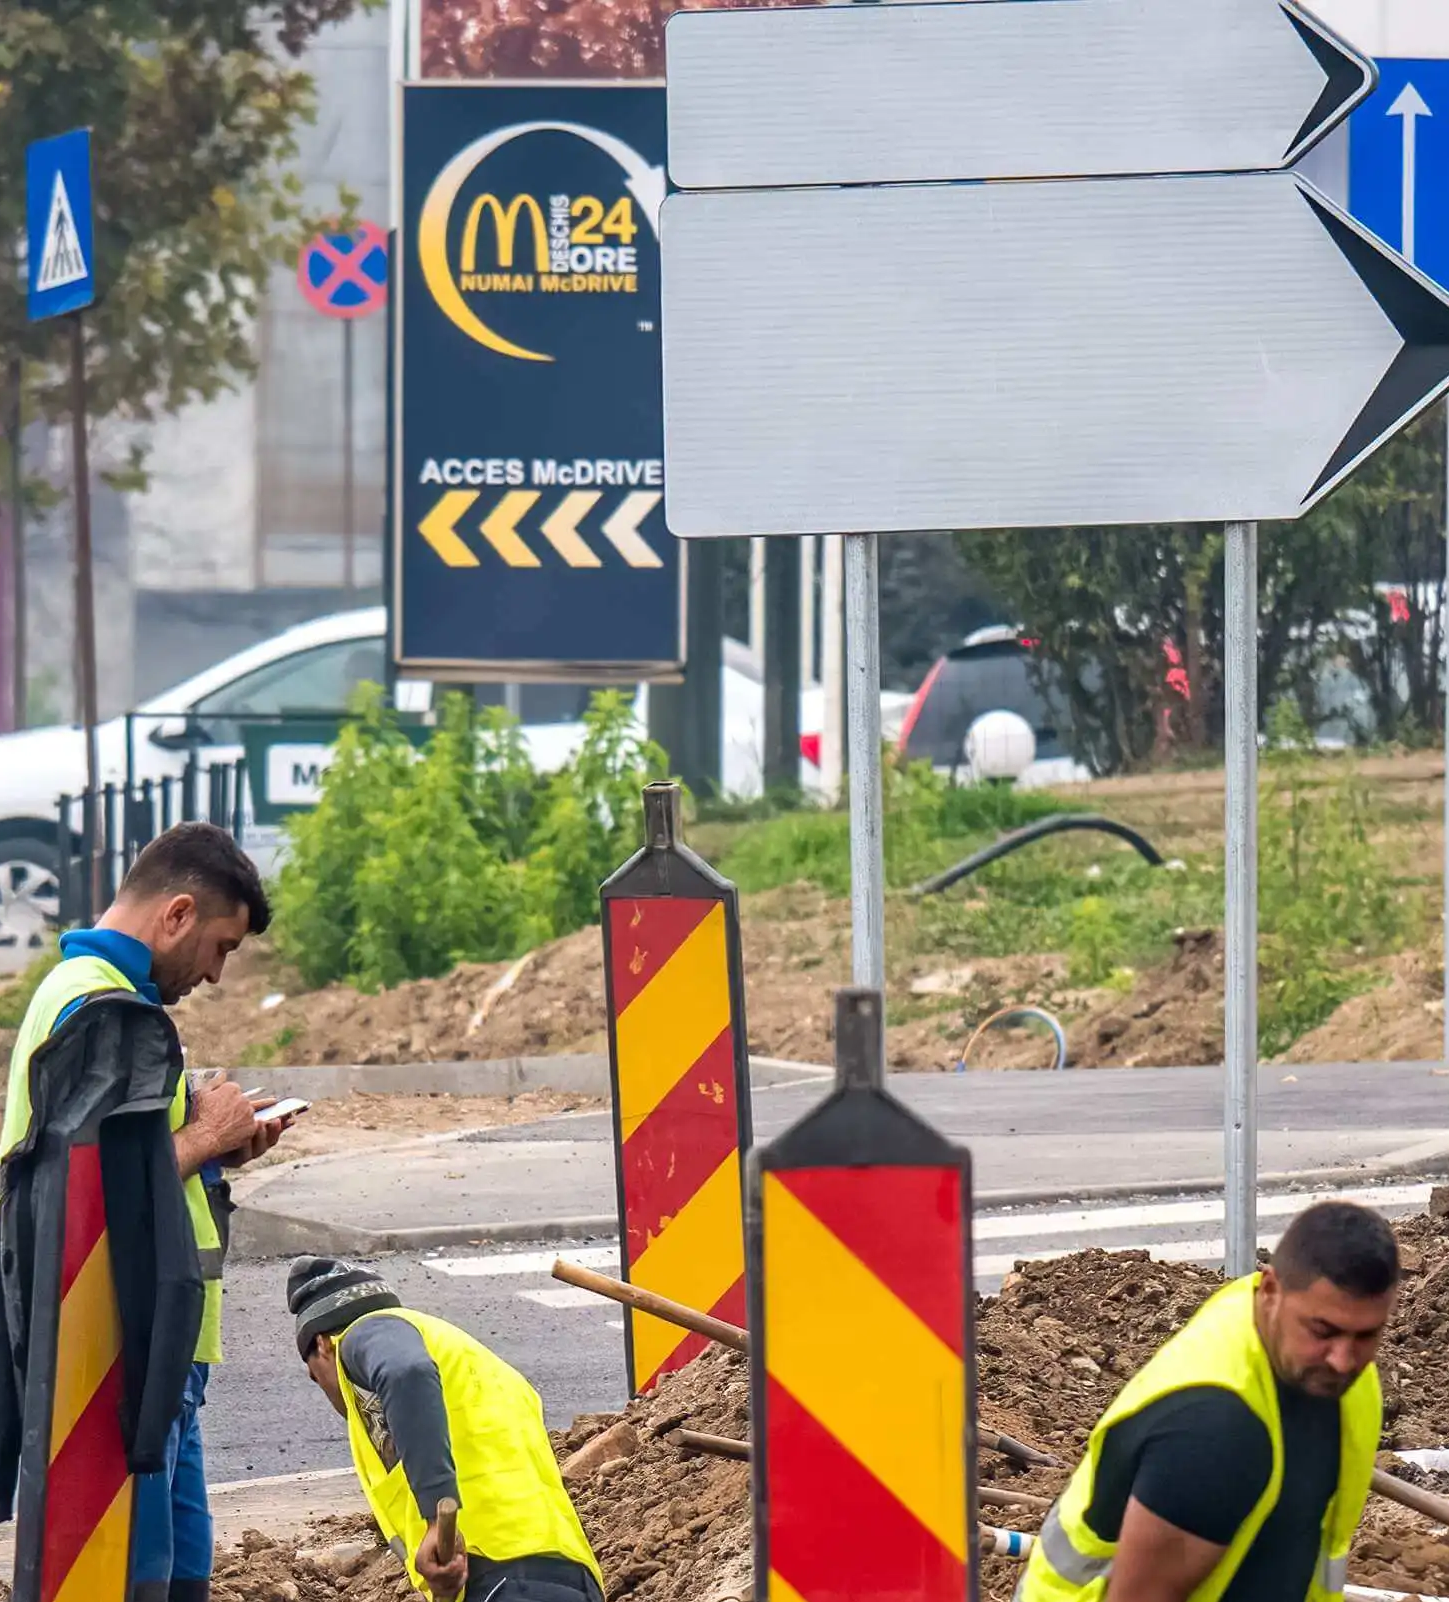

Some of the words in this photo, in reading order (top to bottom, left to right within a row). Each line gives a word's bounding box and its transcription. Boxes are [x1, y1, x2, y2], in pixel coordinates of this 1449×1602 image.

[551, 194, 570, 273] DESCHIS
[570, 194, 638, 245] 24
[569, 246, 639, 274] ORE
[460, 273, 535, 292] NUMAI
[540, 273, 639, 293] McDRIVE
[419, 458, 526, 485] ACCES
[531, 458, 664, 486] McDRIVE
